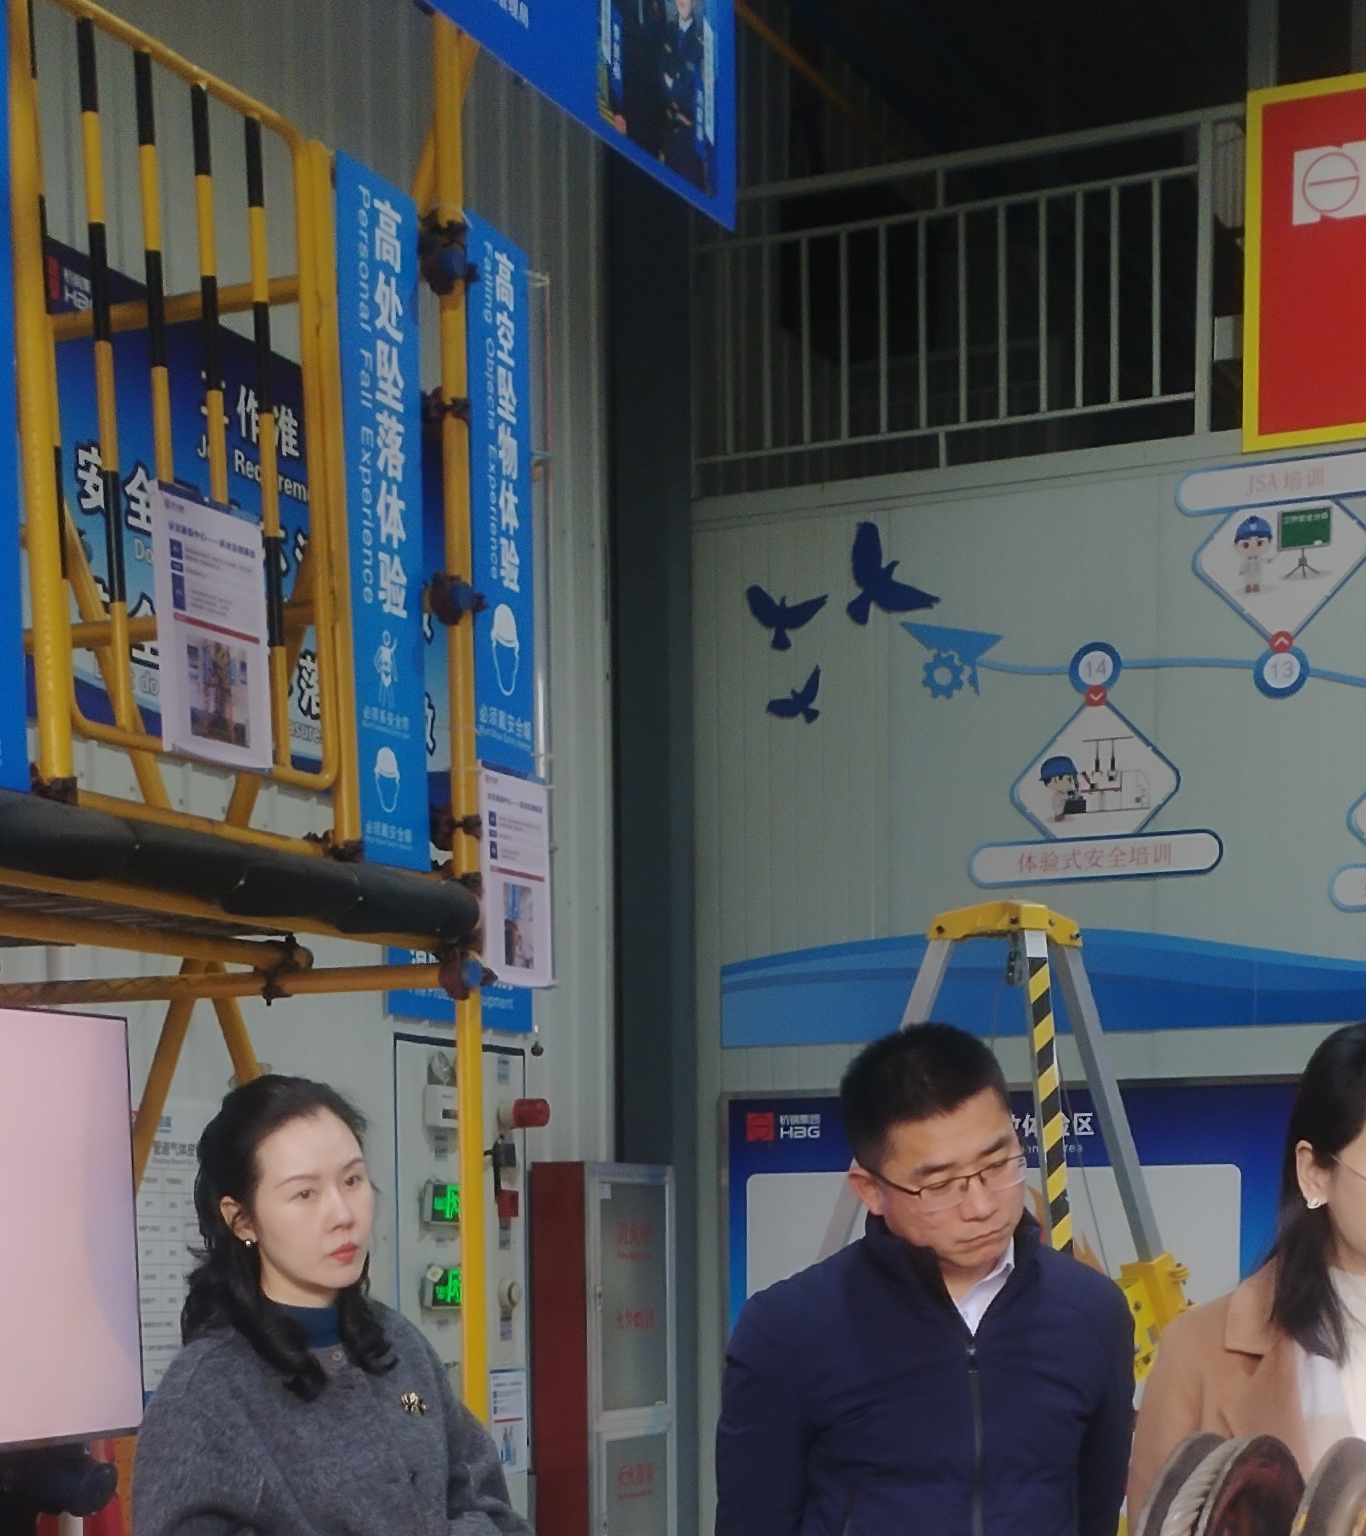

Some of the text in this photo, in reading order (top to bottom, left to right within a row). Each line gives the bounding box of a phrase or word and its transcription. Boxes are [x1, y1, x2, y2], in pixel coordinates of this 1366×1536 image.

[357, 184, 375, 604] Personal Fall Experience
[373, 198, 407, 618] 高处坠落体验
[494, 251, 520, 594] 高空坠物体验
[1085, 659, 1108, 678] 14
[1271, 661, 1294, 679] 13
[1017, 842, 1173, 876] 体验式安全培训
[779, 1126, 821, 1139] HBG
